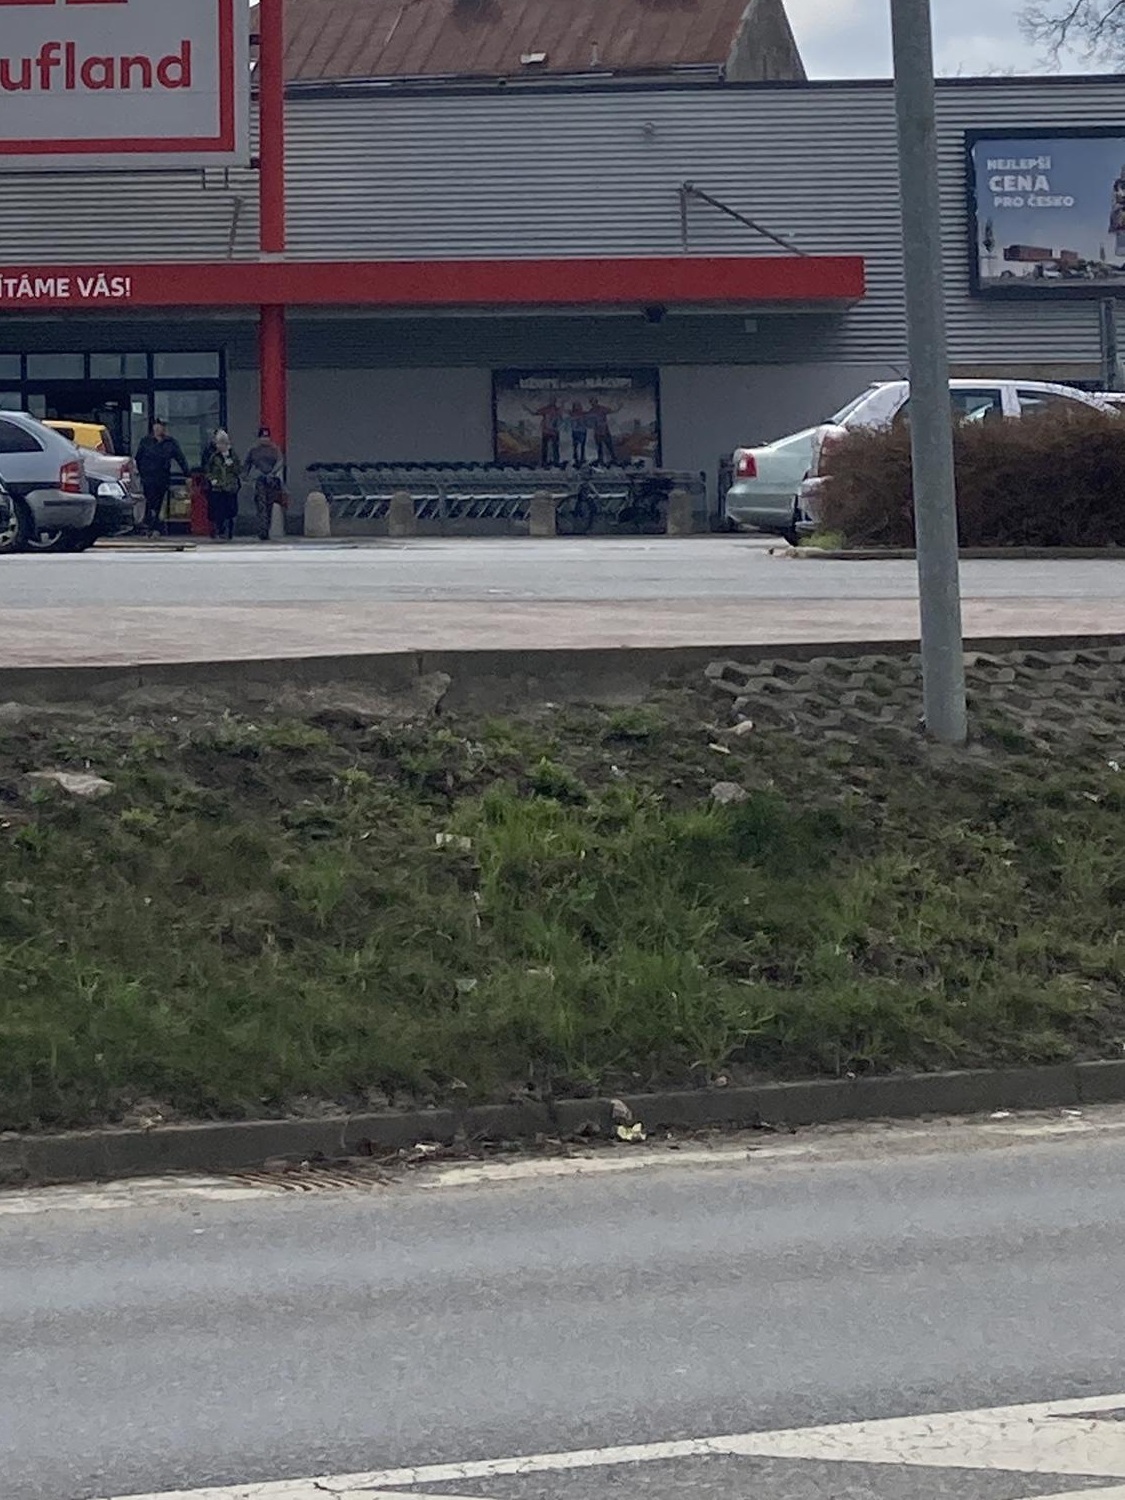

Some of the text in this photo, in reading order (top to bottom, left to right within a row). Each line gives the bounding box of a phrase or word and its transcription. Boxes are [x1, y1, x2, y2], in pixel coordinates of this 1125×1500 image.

[989, 174, 1050, 192] CENA
[993, 194, 1075, 207] PRO ČESKO
[76, 273, 131, 297] VÁS!
